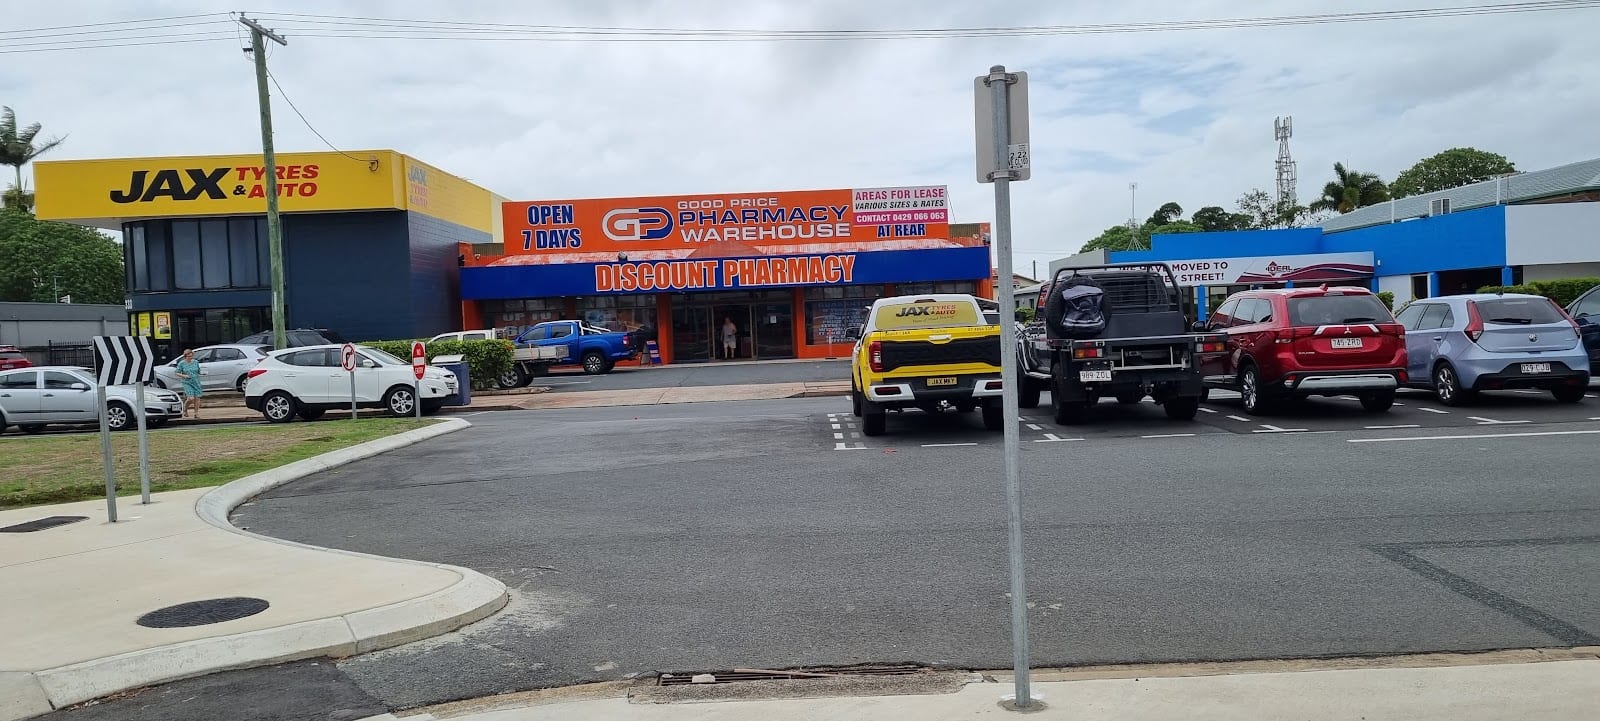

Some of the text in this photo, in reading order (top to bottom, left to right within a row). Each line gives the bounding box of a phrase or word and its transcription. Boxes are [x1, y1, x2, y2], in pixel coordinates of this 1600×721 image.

[236, 165, 319, 181] TYRES
[110, 168, 231, 203] JAX
[233, 185, 246, 195] &
[855, 188, 944, 200] AREAS FOR LEASE
[677, 198, 778, 210] GOOD PRICE
[855, 202, 888, 210] VARIOUS
[889, 201, 910, 209] SIZES
[527, 204, 574, 226] OPEN
[678, 205, 850, 226] PHARMACY
[856, 211, 945, 223] CONTACT 0429 066 063
[602, 207, 674, 241] GP
[877, 223, 926, 238] AT REAR
[521, 228, 582, 250] 7 DAYS
[680, 223, 851, 243] WAREHOUSE
[595, 255, 856, 292] DISCOUNT PHARMACY
[1172, 262, 1210, 272] MOVED
[1214, 261, 1228, 270] TO
[1181, 272, 1224, 282] STREET!
[895, 306, 930, 317] JAX
